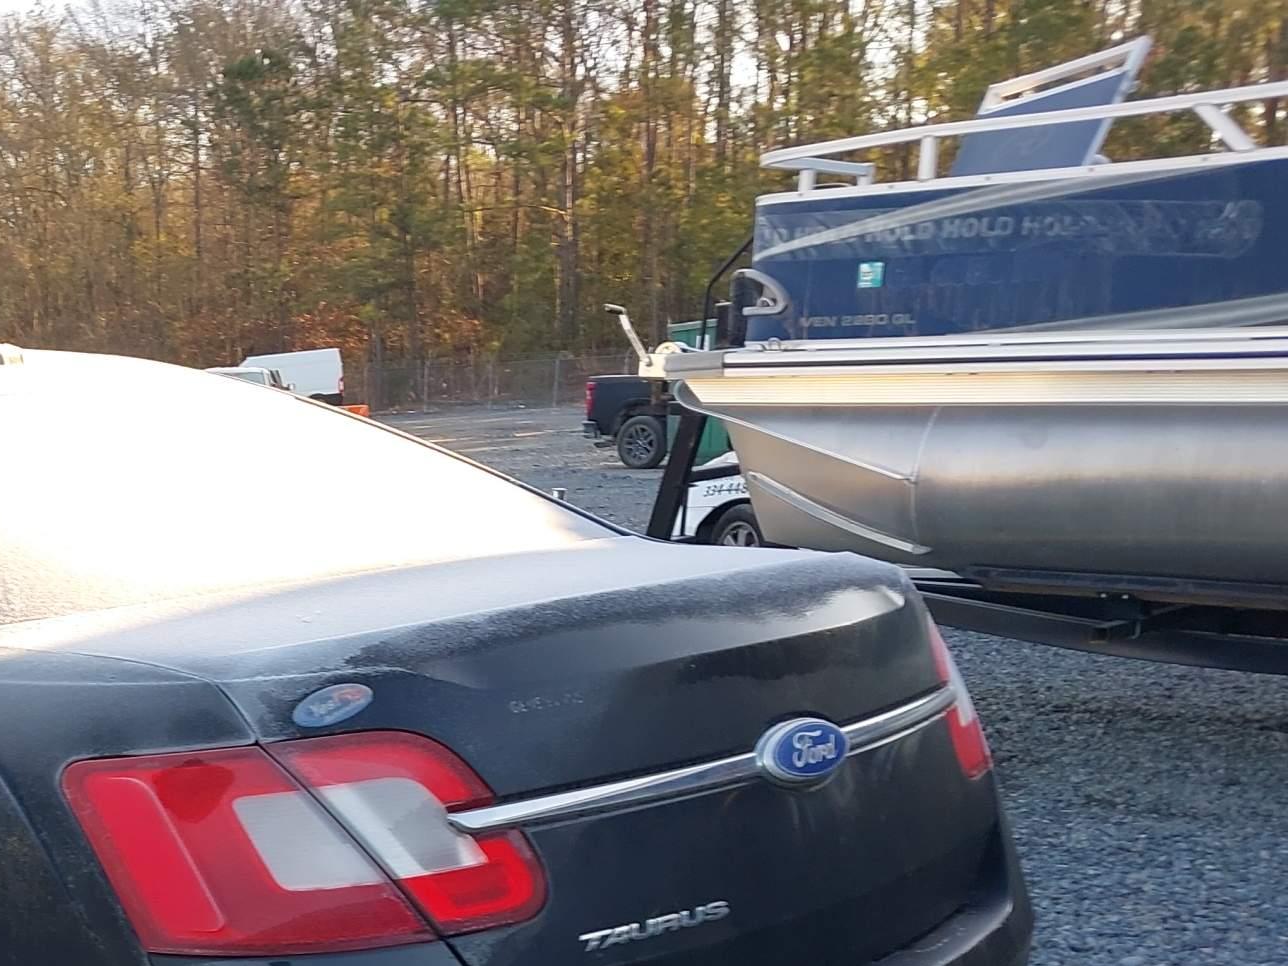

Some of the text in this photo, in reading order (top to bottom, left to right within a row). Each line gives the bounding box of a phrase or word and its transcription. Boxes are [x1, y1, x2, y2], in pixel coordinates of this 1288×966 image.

[942, 216, 1013, 239] HOLD
[792, 729, 837, 768] Ford
[578, 900, 731, 952] TAURUS
